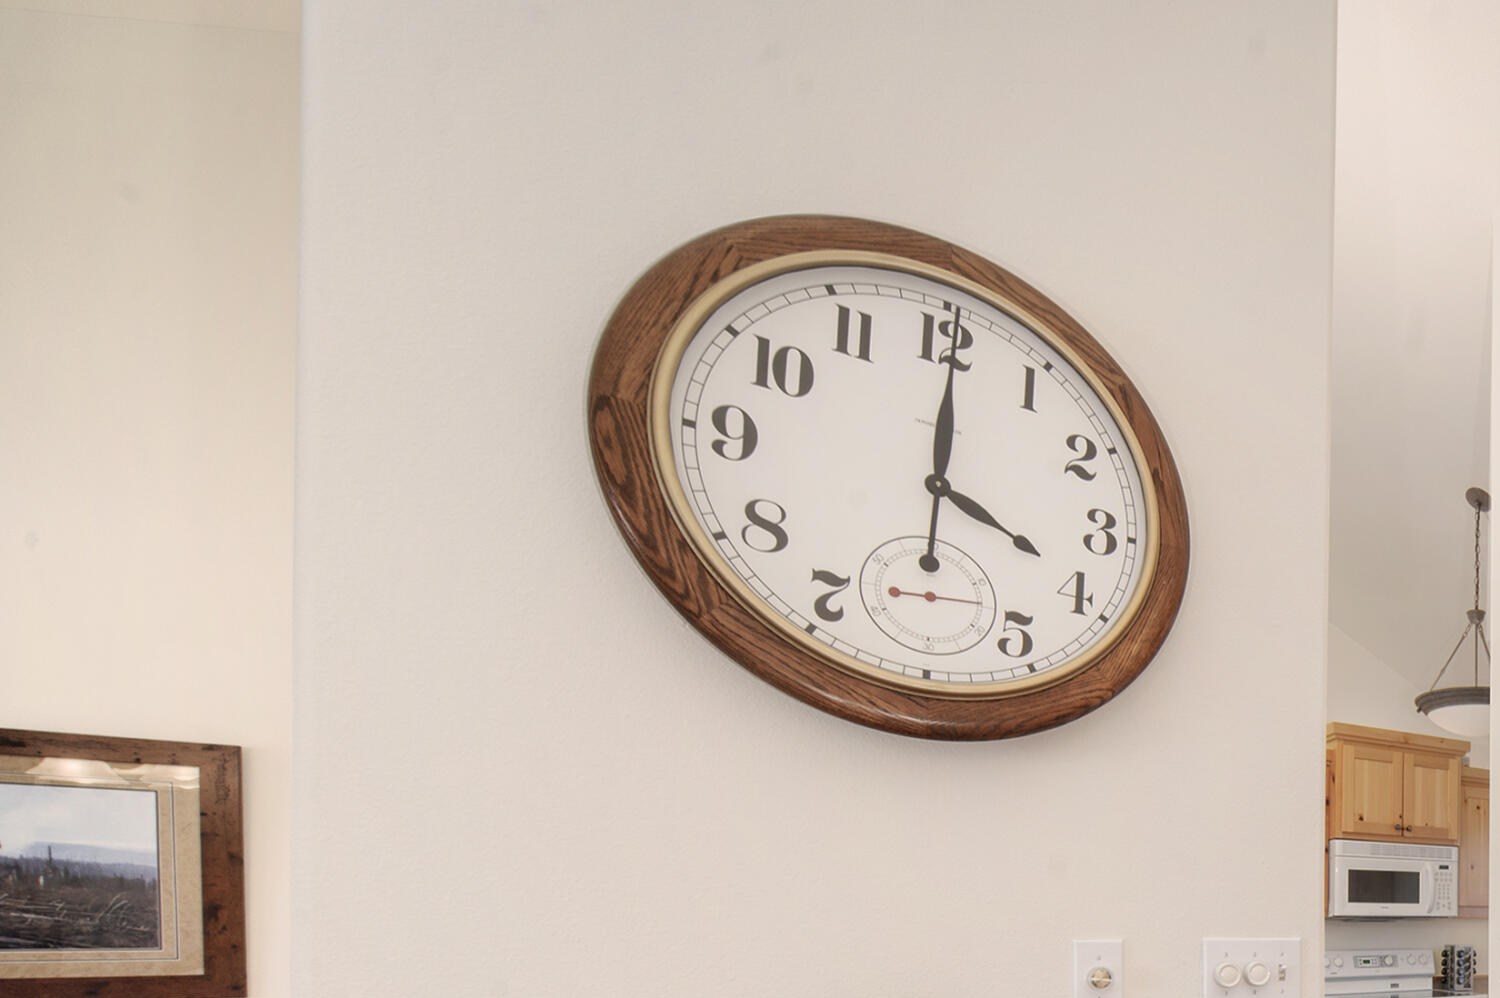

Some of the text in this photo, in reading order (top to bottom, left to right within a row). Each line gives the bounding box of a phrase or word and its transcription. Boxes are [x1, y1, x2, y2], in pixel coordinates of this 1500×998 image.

[832, 303, 874, 363] 11
[916, 311, 973, 372] 12
[751, 334, 815, 398] 10
[1020, 365, 1038, 413] 1
[711, 405, 758, 461] 9
[1064, 434, 1098, 481] 2
[740, 498, 789, 552] 8
[1083, 508, 1118, 556] 3
[811, 568, 851, 622] 7
[1056, 571, 1094, 616] 4
[997, 611, 1034, 658] 5
